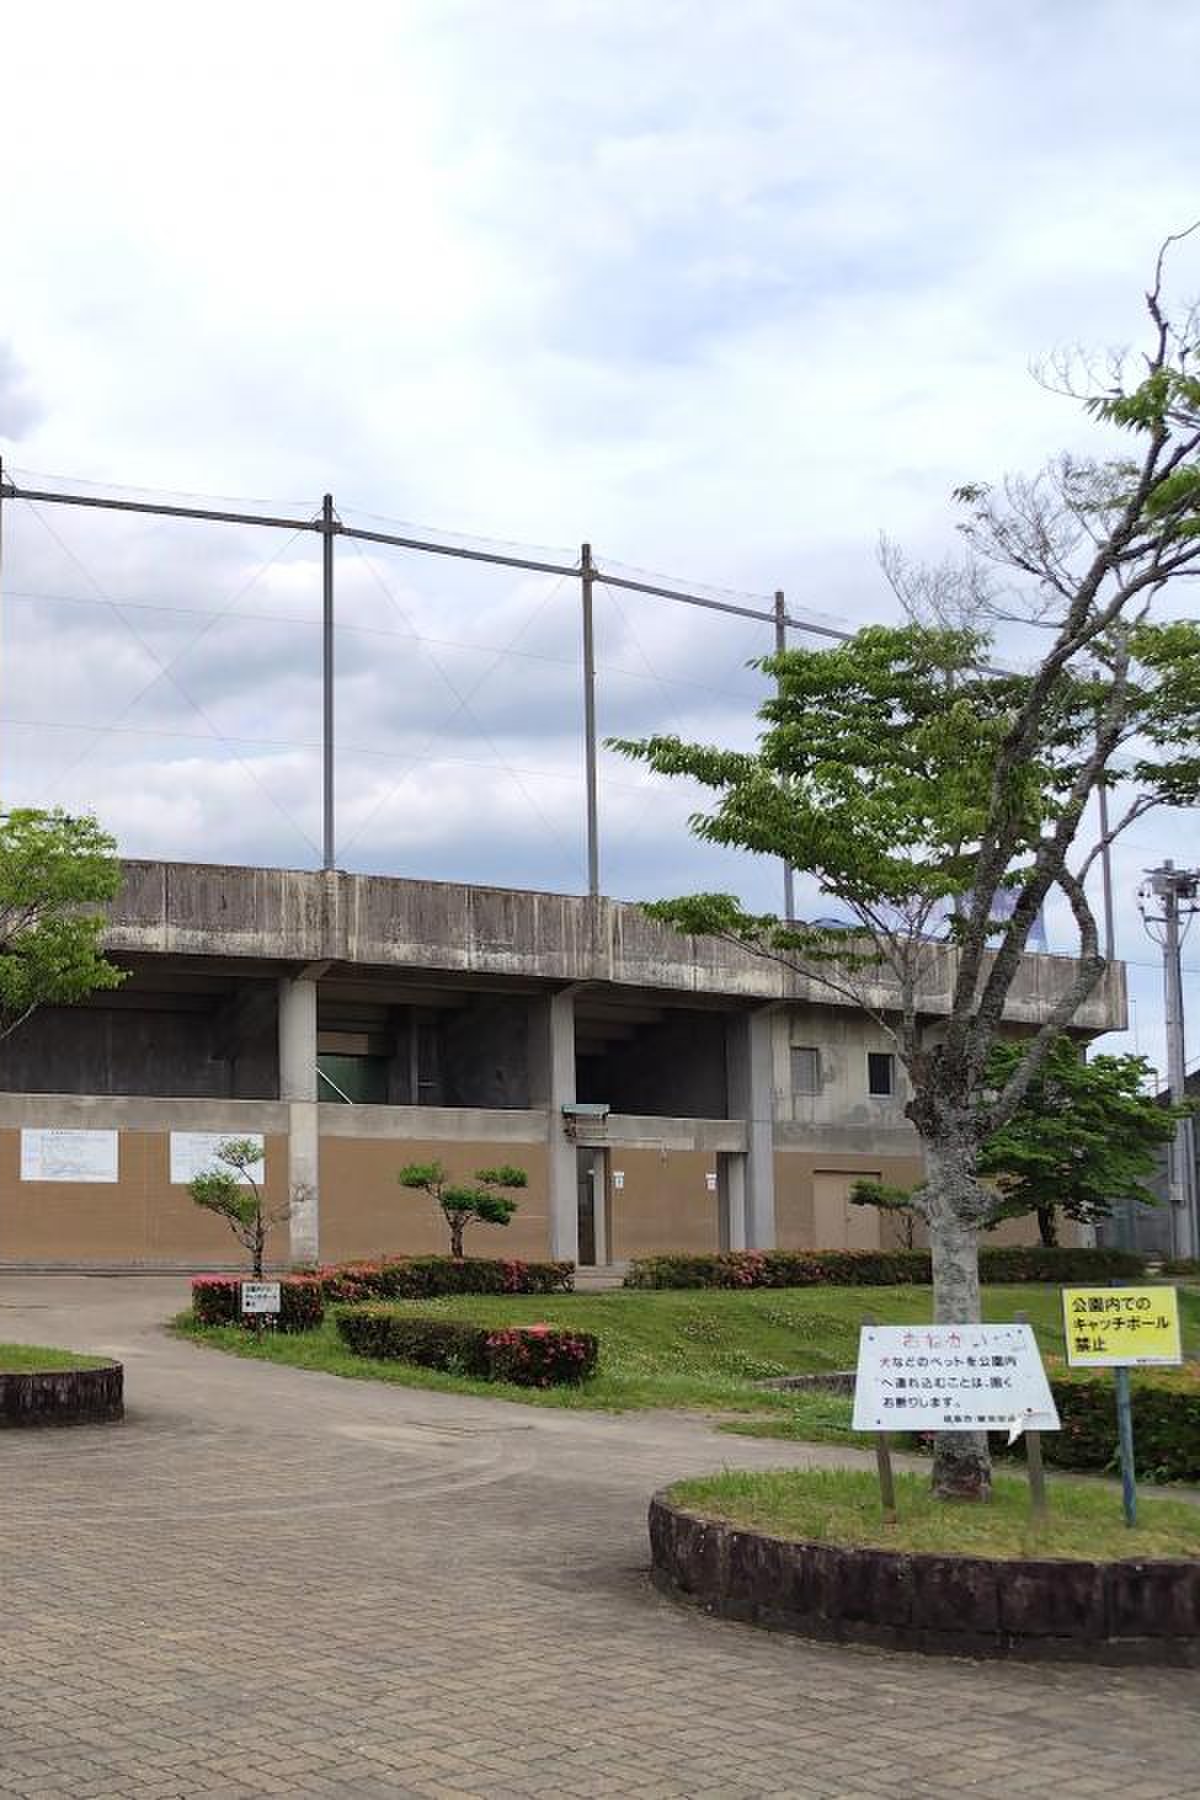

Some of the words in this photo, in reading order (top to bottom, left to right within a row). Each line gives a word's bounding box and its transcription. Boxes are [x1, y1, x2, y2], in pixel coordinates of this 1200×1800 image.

[1072, 1296, 1151, 1312] 公園内での
[1072, 1315, 1169, 1331] キャッチボール
[1075, 1336, 1107, 1352] 禁止
